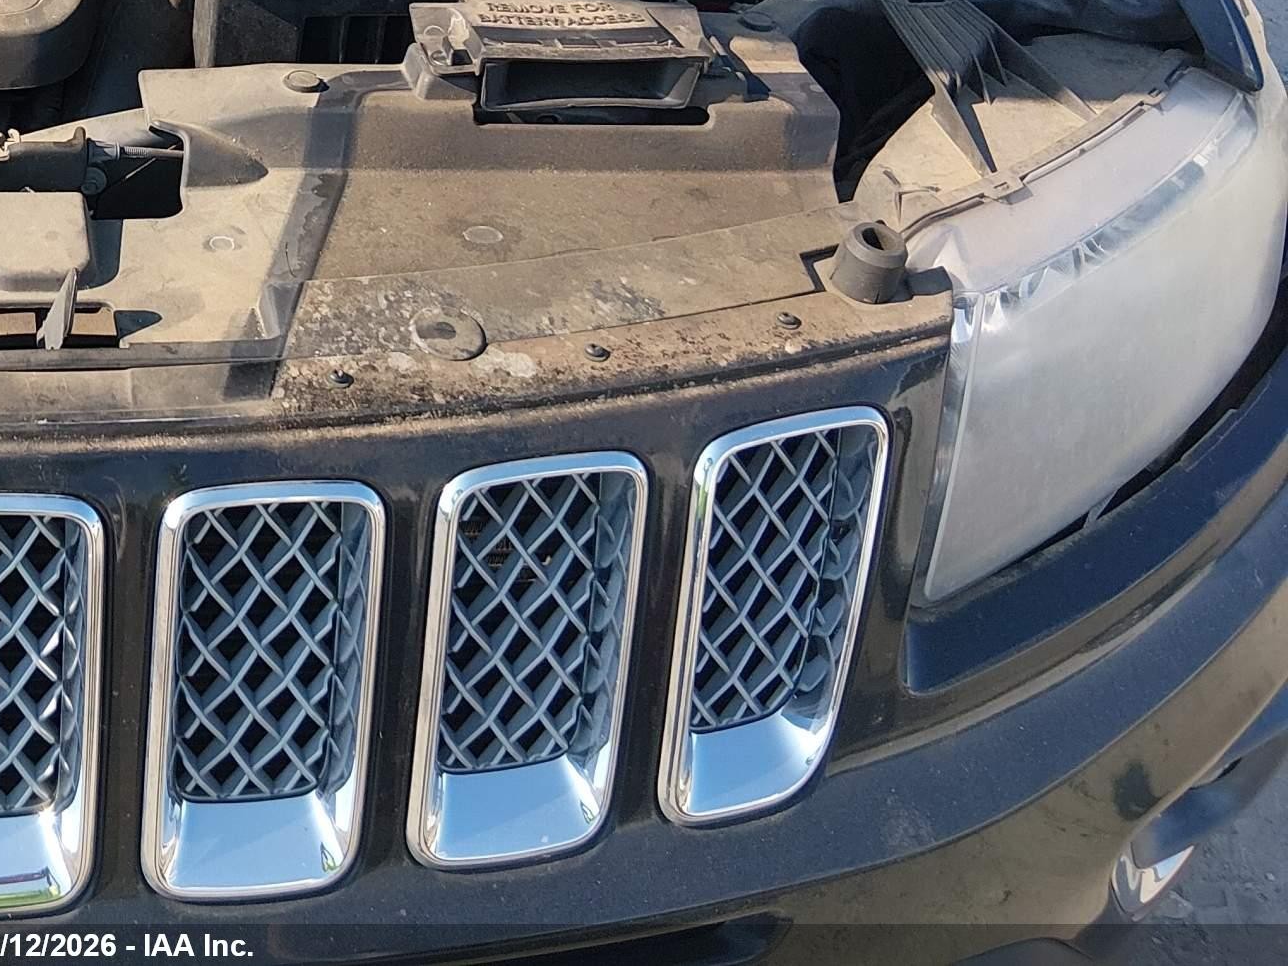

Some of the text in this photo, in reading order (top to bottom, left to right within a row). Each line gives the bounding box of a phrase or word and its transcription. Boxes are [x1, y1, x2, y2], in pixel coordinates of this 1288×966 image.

[486, 1, 615, 14] REMOVE FOR
[477, 12, 646, 26] BATTERY ACCESS
